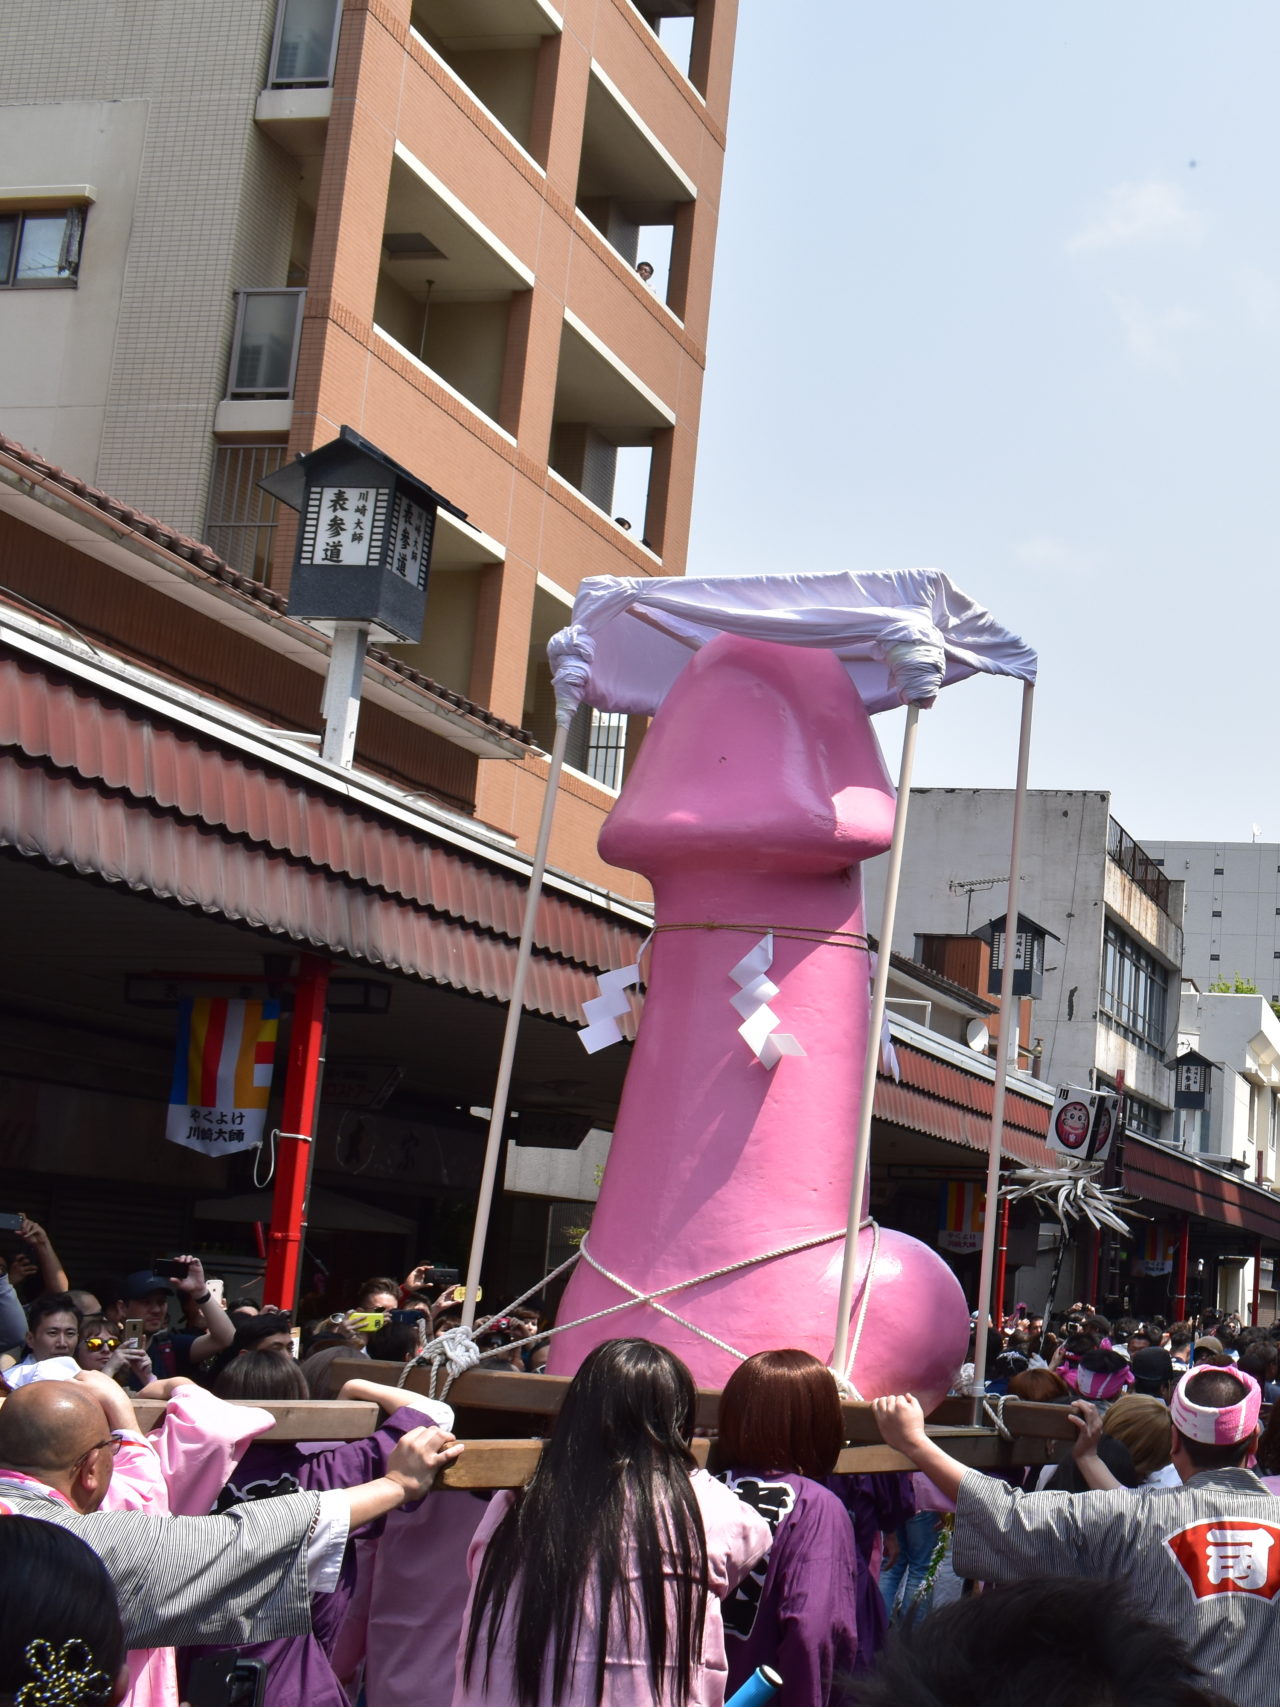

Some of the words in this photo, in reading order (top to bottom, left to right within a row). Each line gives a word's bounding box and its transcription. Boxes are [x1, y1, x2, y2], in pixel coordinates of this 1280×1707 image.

[321, 489, 350, 564] 表参道
[395, 500, 415, 578] 表参道
[190, 1108, 246, 1126] やくよけ
